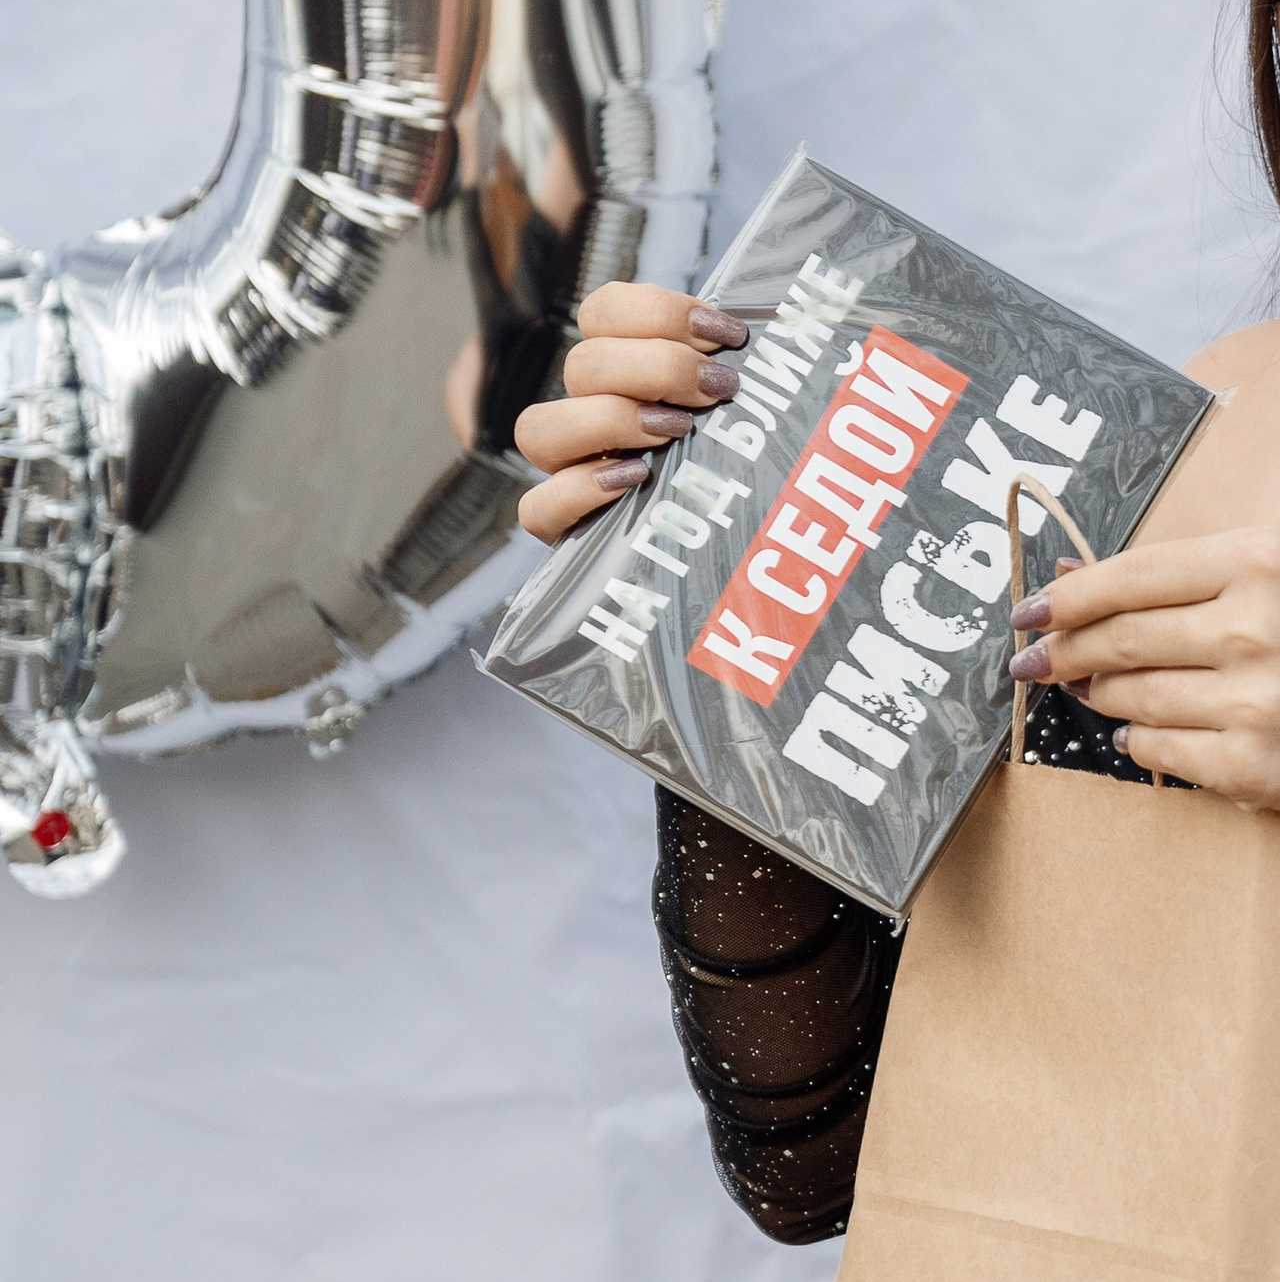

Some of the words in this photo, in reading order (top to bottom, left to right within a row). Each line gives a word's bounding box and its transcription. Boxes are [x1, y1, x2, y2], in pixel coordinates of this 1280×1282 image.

[577, 576, 669, 663] НА
[630, 459, 752, 577] ГОД
[703, 253, 865, 462] БЛИЖЕ
[747, 339, 953, 615] СЕДОЙ
[782, 374, 1103, 806] ПИСЬКЕ
[702, 607, 795, 686] К
